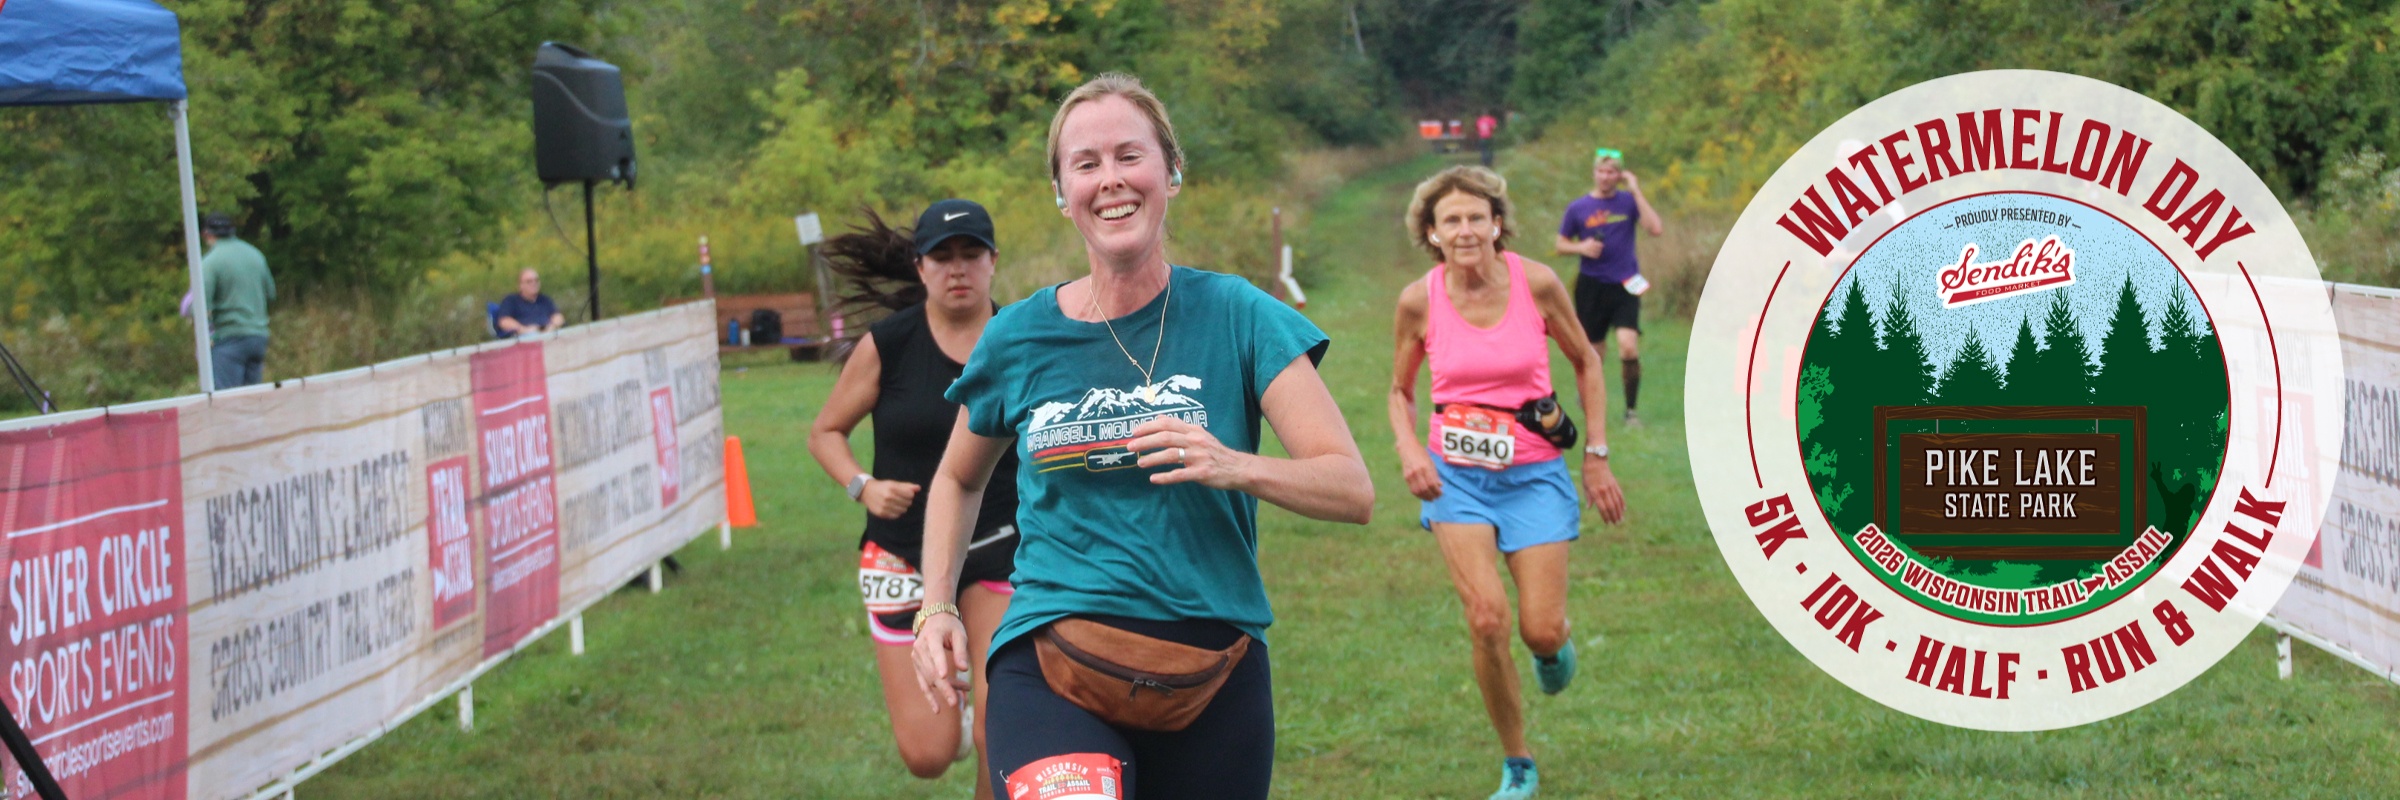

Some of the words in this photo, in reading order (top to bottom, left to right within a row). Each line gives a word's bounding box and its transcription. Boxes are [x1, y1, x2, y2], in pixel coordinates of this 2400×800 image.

[1027, 424, 1096, 453] WRANGELL
[1183, 410, 1208, 428] AIR
[1444, 431, 1509, 460] 5640
[206, 466, 336, 606] WISCONSIN'S
[9, 546, 91, 646] SILVER
[98, 525, 173, 616] CIRCLE
[863, 575, 923, 599] 5787
[10, 637, 95, 731] SPORTS
[101, 613, 176, 702] EVENTS
[1035, 761, 1090, 783] WISCONSIN
